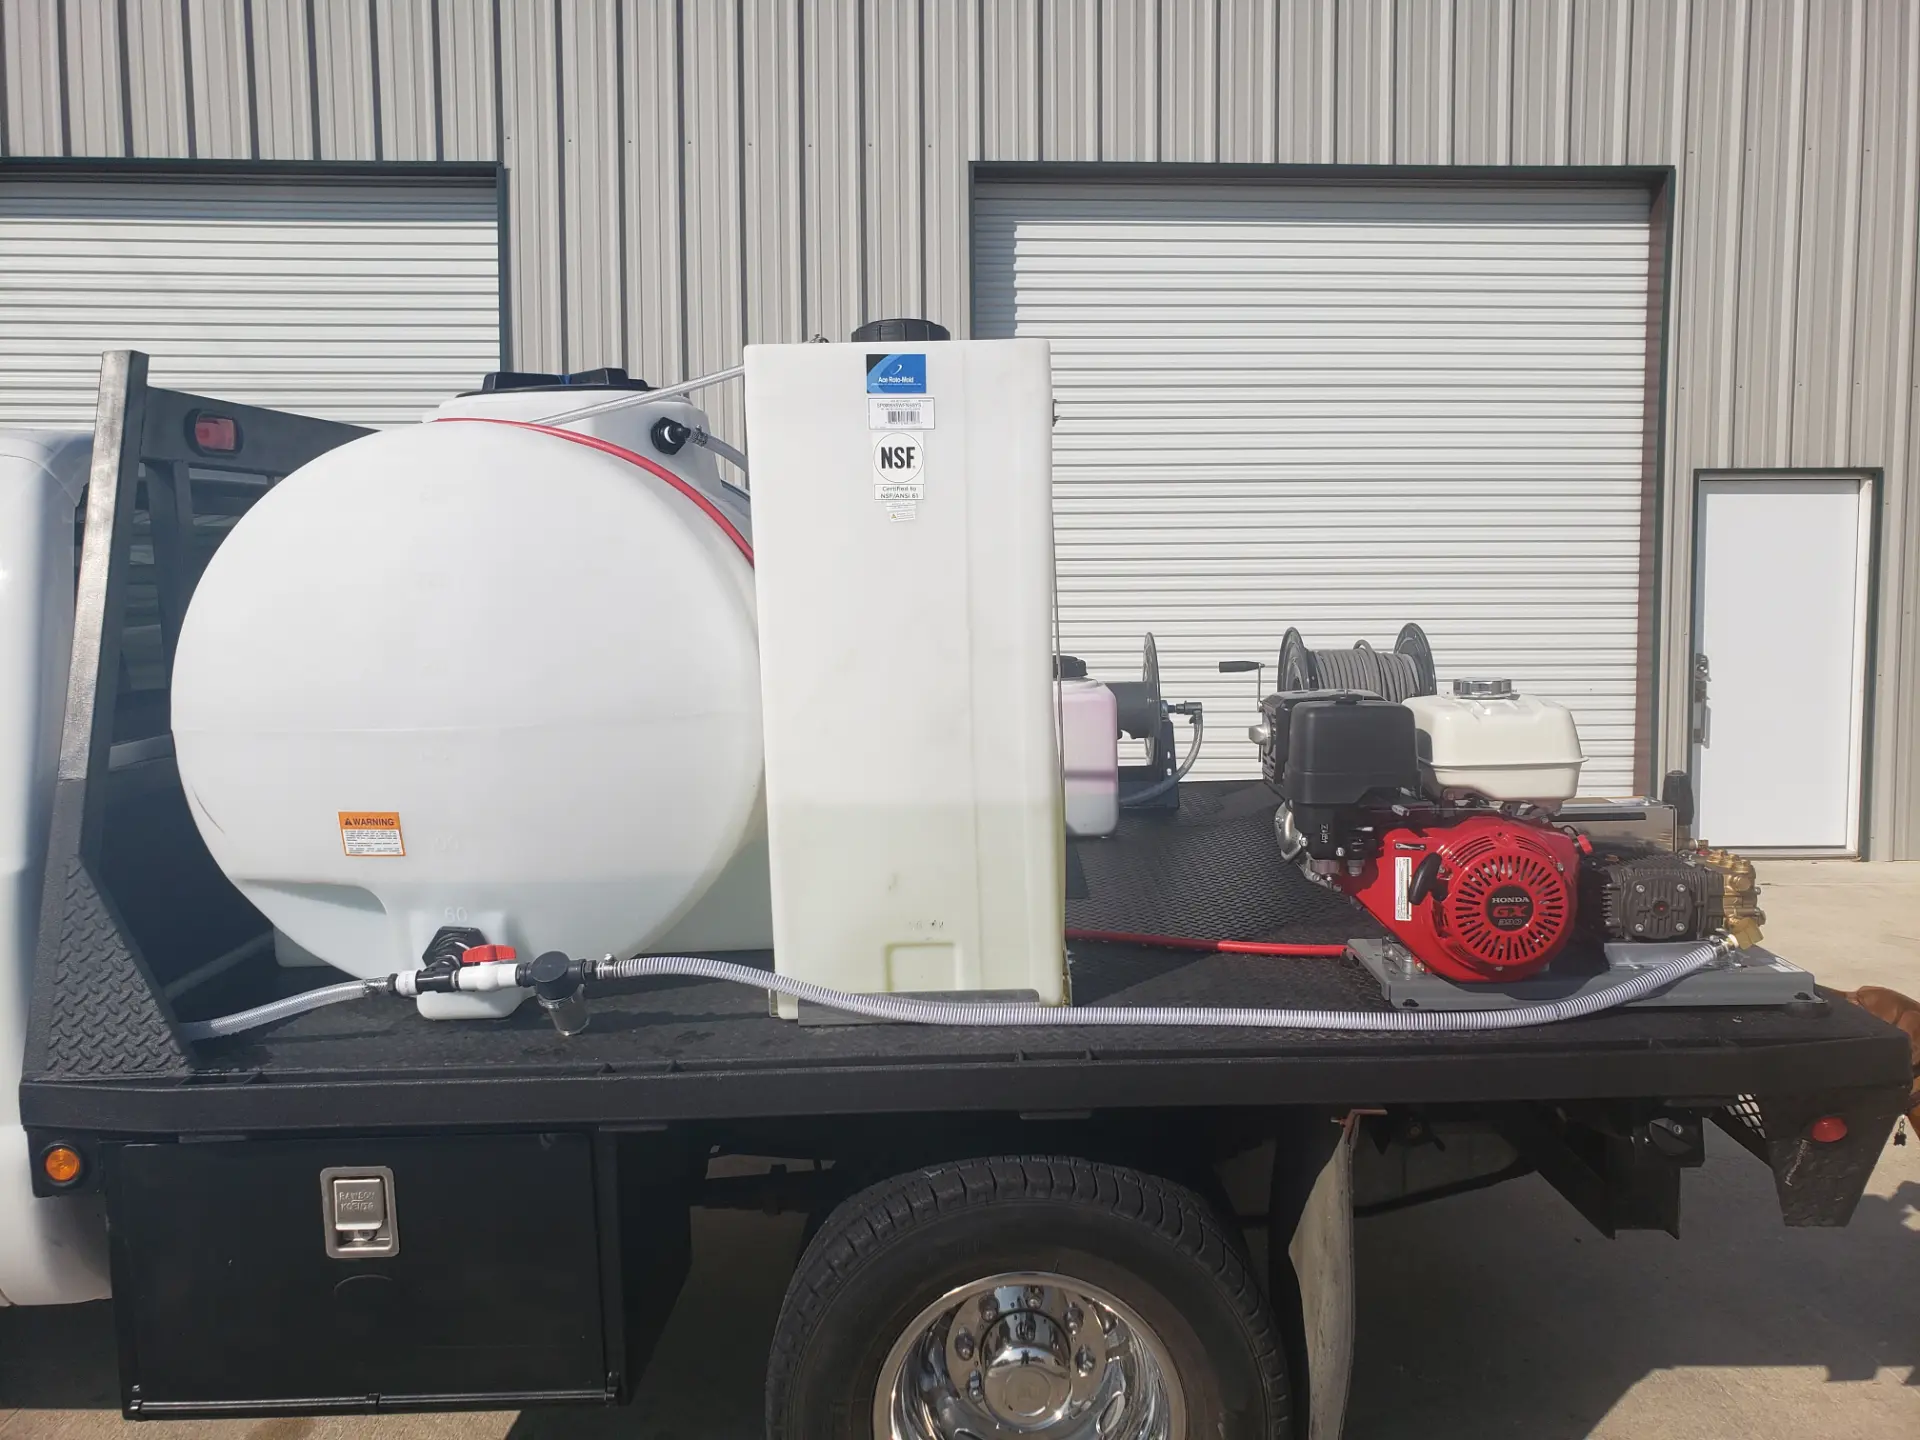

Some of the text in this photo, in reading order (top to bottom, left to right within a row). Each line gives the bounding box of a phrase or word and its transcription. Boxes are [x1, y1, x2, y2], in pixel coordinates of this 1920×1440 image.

[881, 447, 915, 469] NSF
[353, 818, 395, 826] WARNING
[1493, 905, 1529, 917] GX
